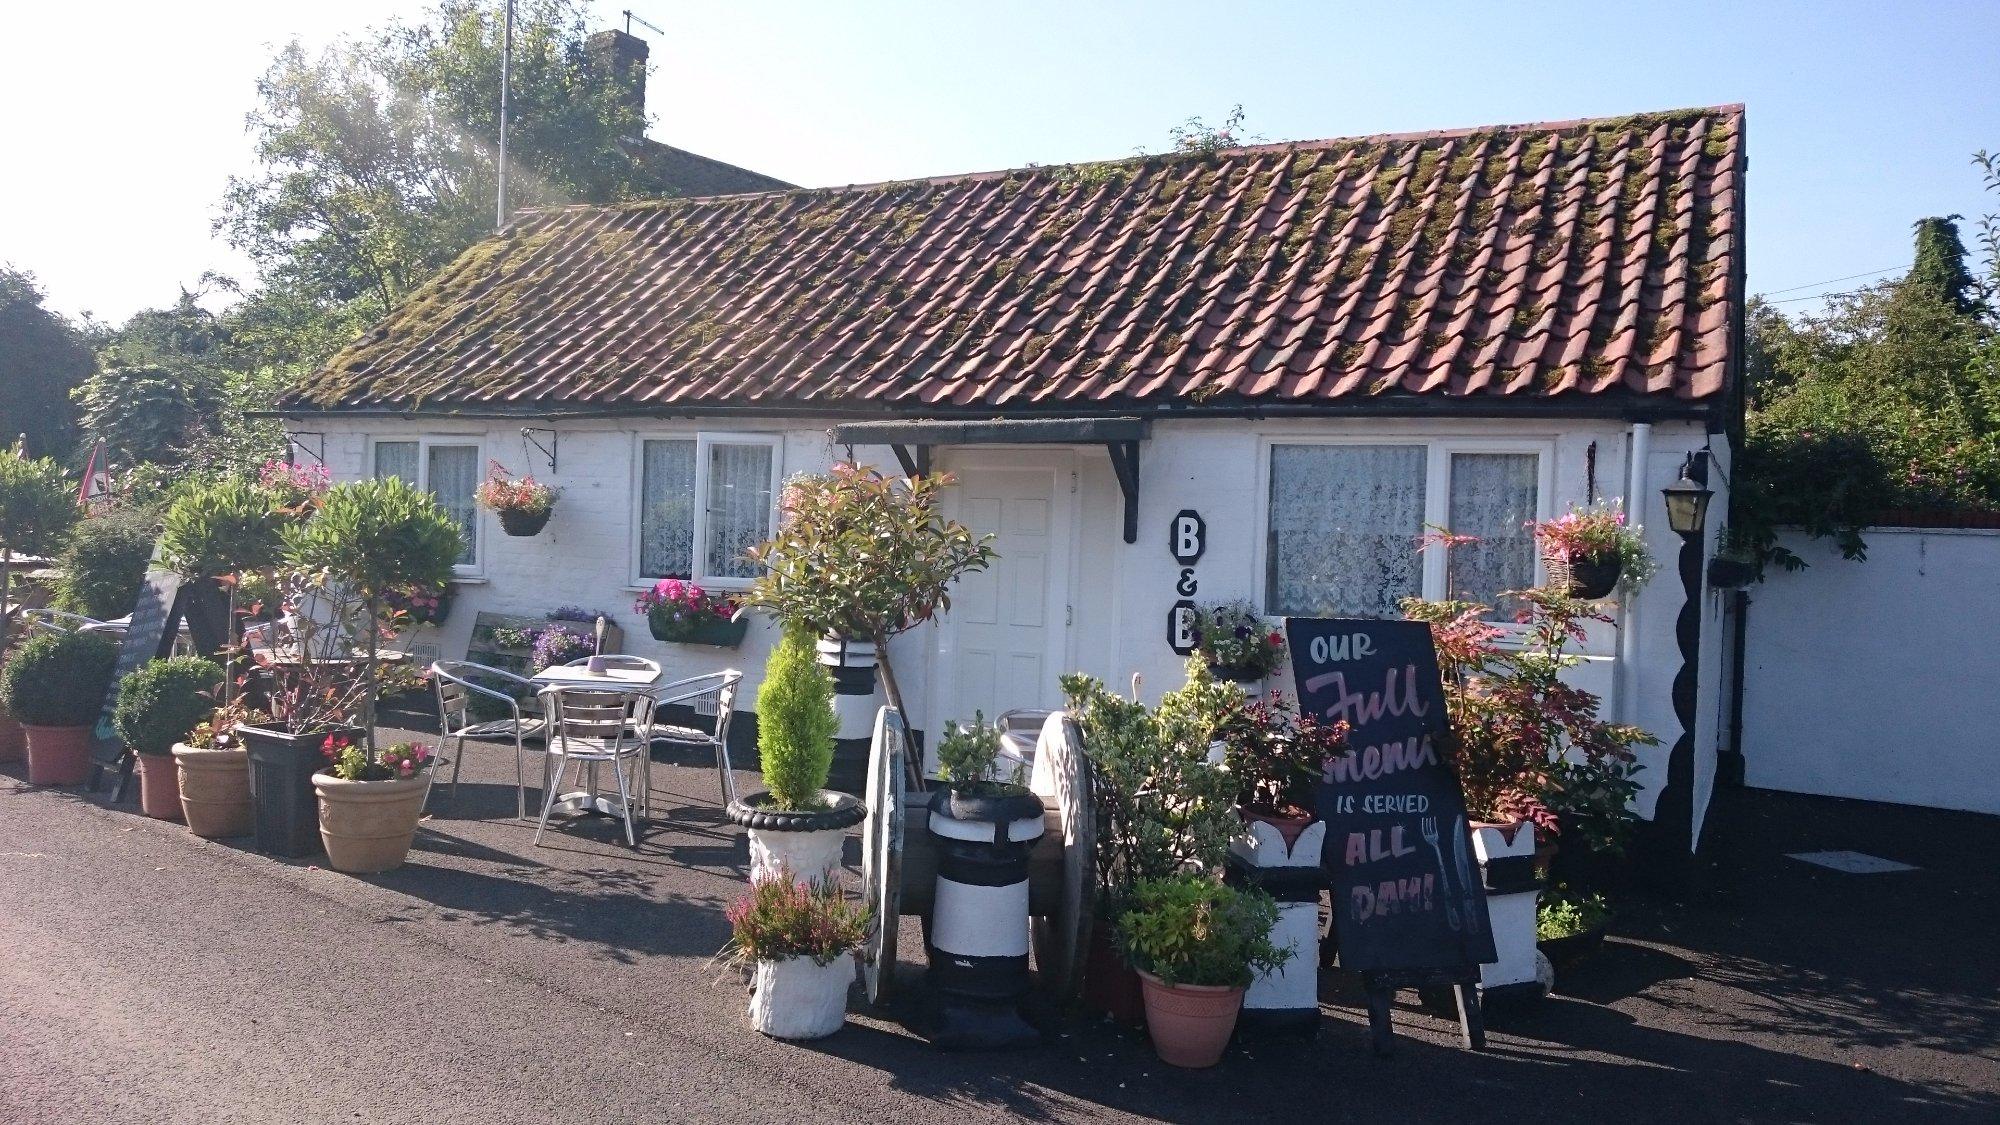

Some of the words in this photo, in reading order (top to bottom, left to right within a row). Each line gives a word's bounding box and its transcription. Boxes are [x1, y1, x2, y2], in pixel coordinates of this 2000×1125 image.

[1310, 633, 1378, 664] OUR
[1305, 664, 1430, 738] Full
[1322, 733, 1437, 784] menu
[1336, 795, 1355, 814] IS
[1362, 794, 1429, 814] SERVED
[1345, 826, 1416, 866] ALL
